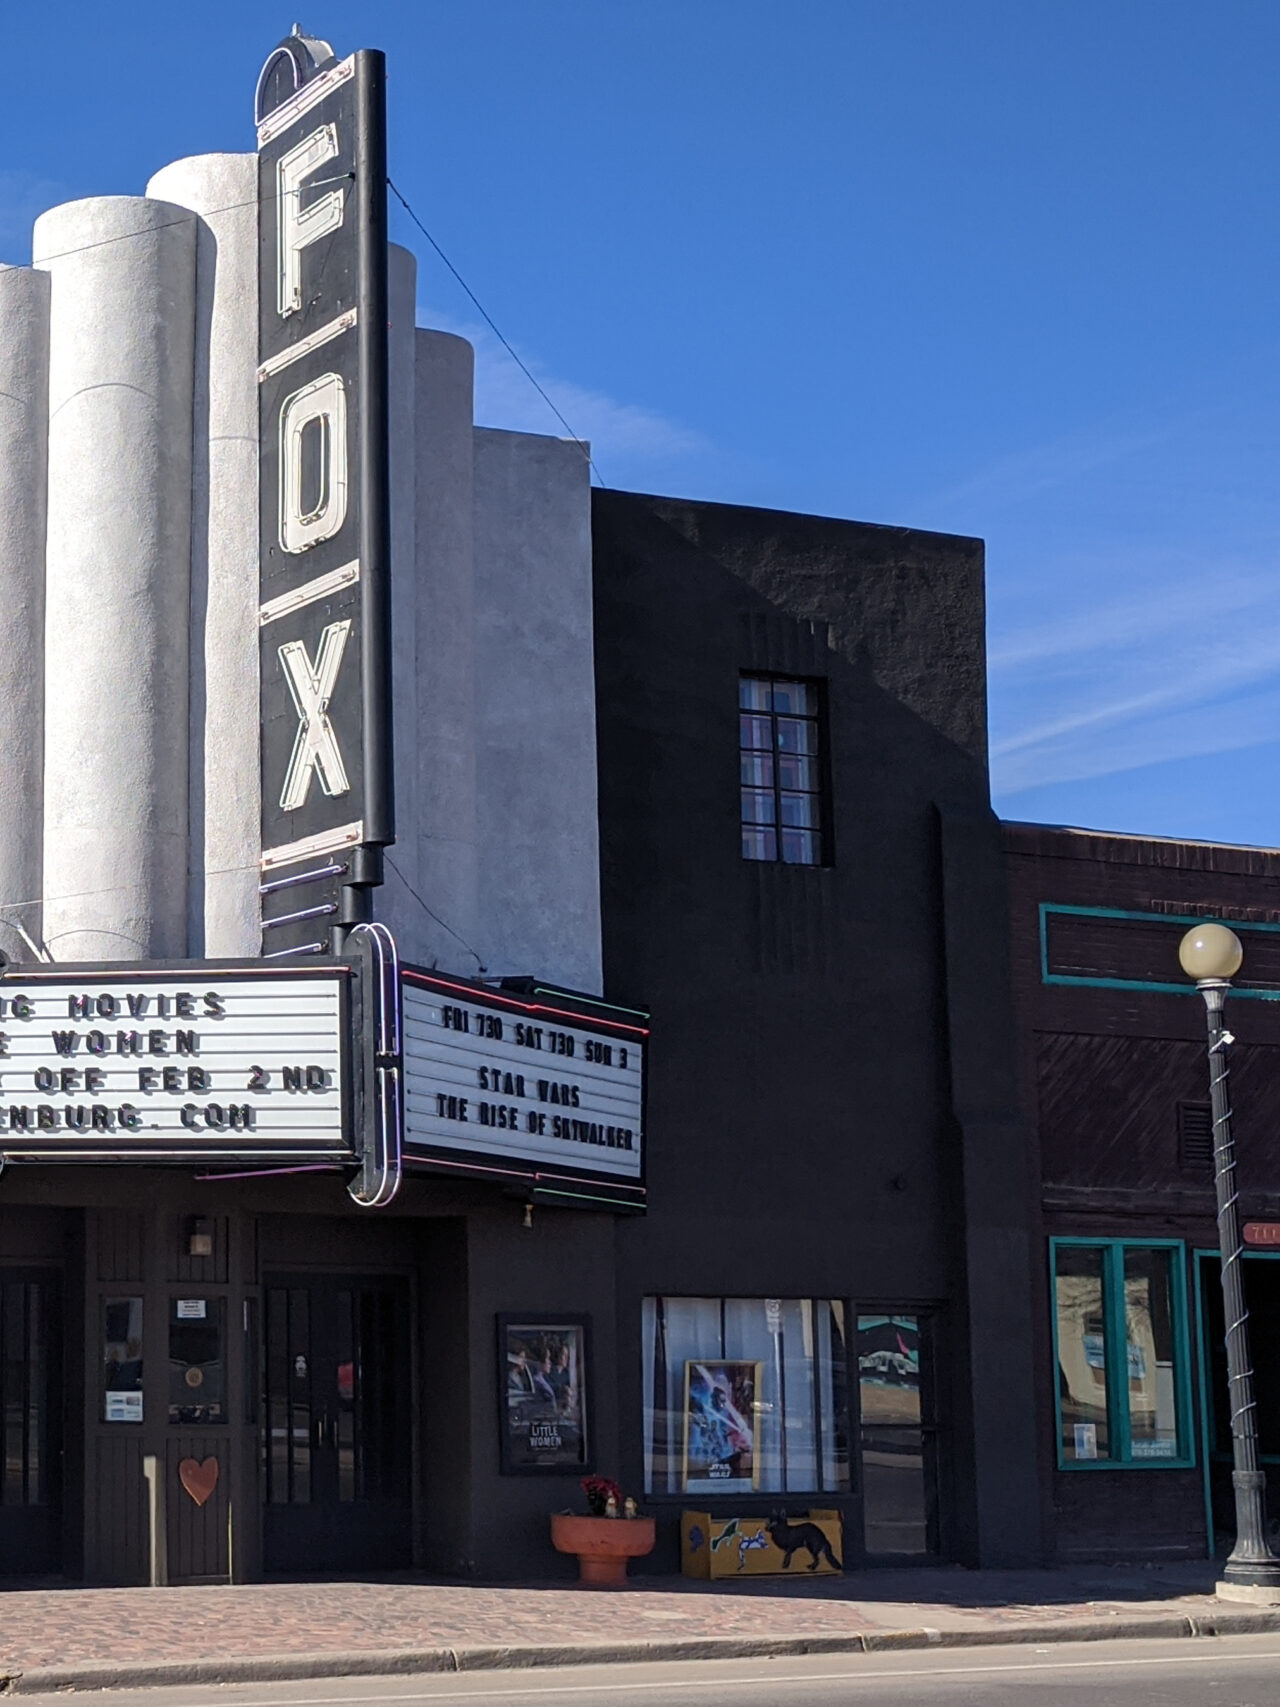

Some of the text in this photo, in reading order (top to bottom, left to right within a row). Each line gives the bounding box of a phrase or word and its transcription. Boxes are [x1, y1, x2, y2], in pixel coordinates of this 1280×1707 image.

[276, 121, 352, 812] FOX
[68, 991, 224, 1018] MOVIES
[51, 1029, 196, 1055] WOMEN
[443, 1005, 628, 1069] FRI 730 SAT 730 SUN 3
[34, 1066, 102, 1092] OFF
[138, 1065, 206, 1091] FEB
[480, 1066, 580, 1108] STAR WARS
[437, 1093, 633, 1151] THE RISE OF SKYWALKER
[530, 1436, 562, 1447] WOMEN
[531, 1425, 558, 1437] LITTLE
